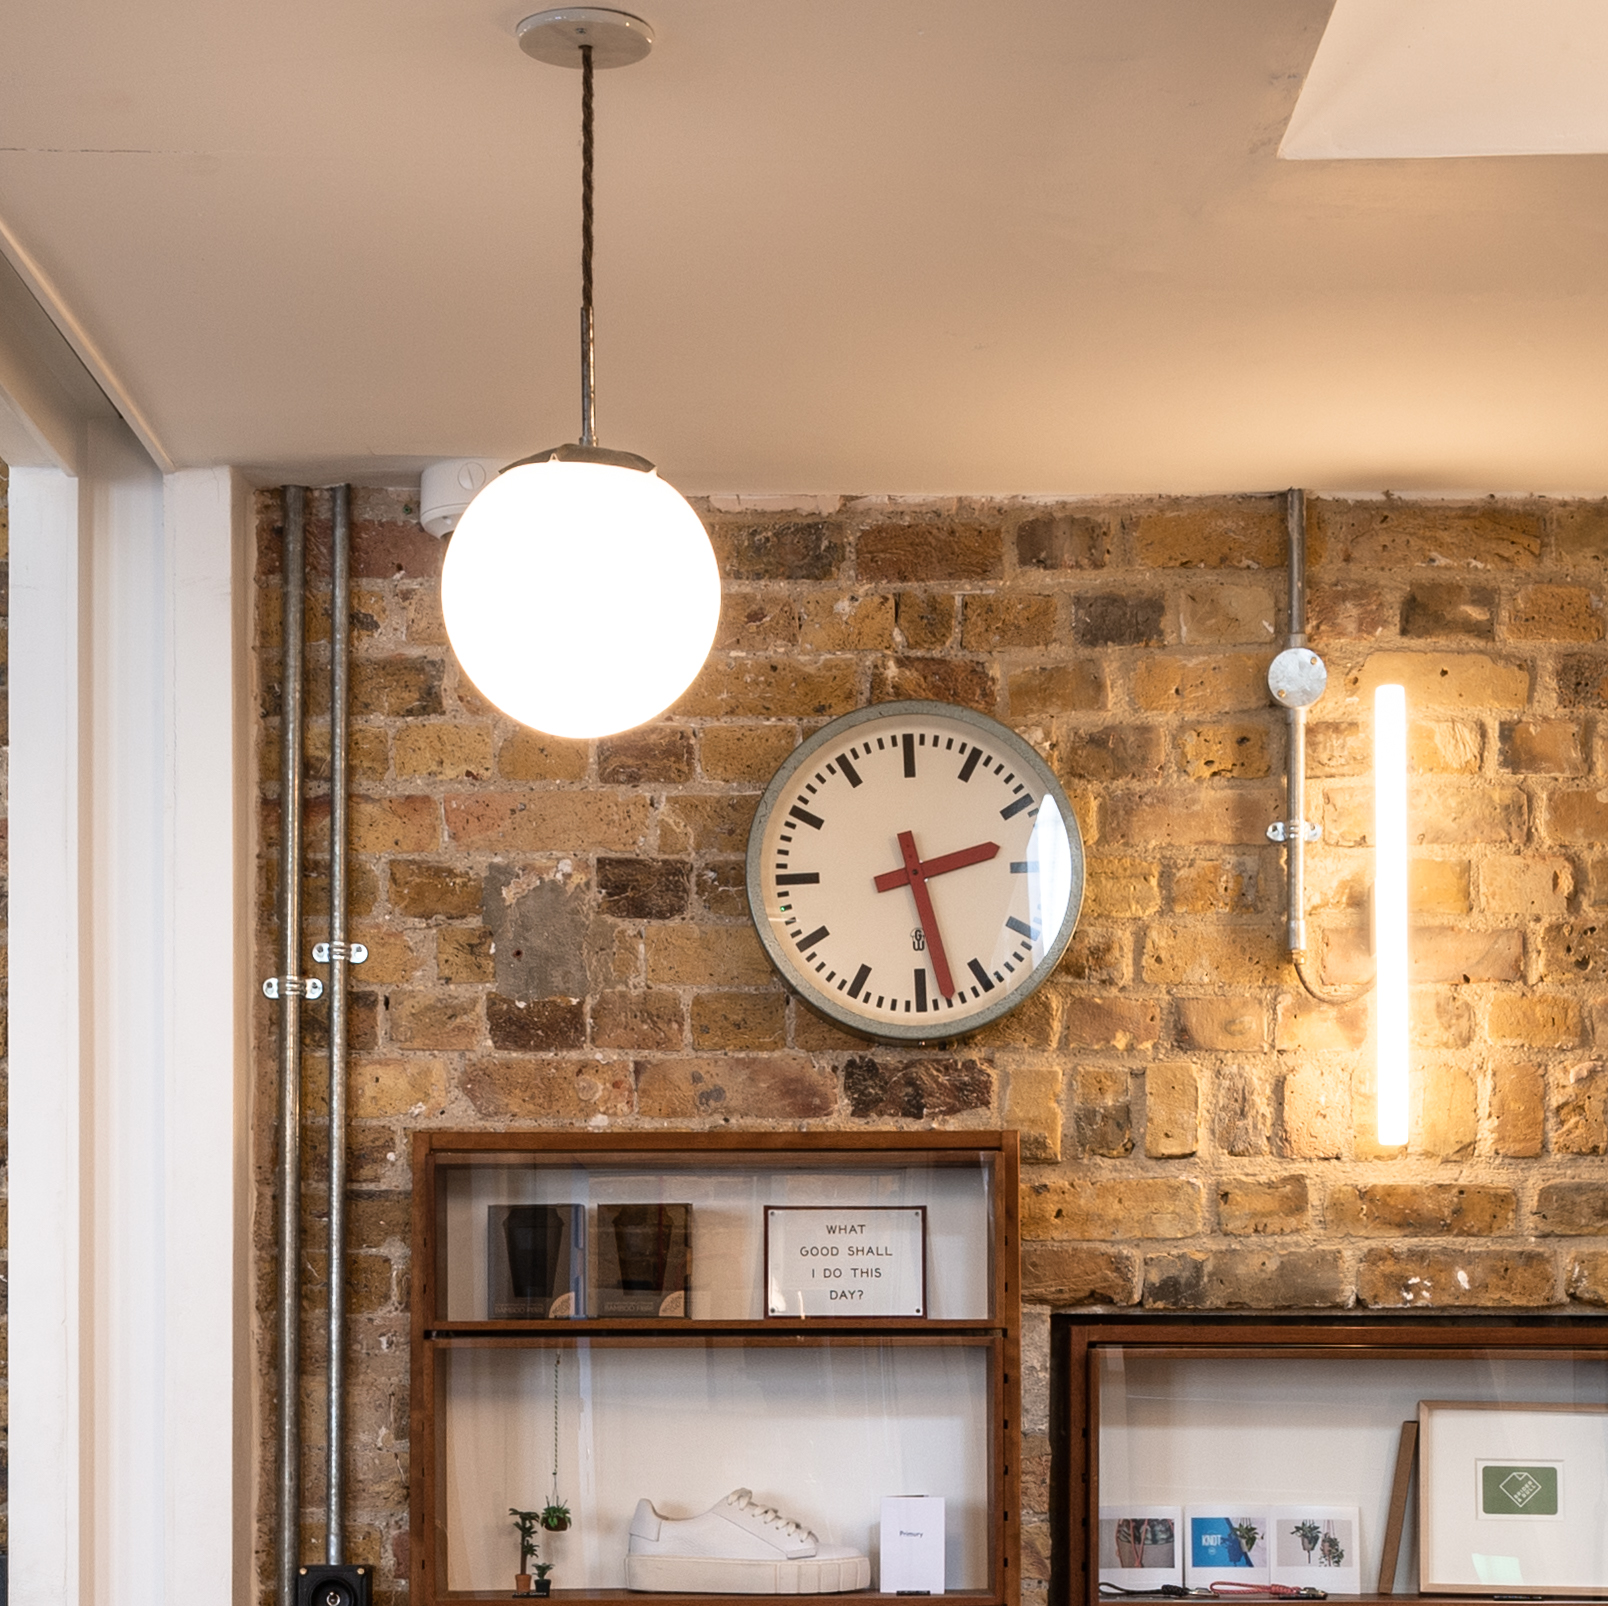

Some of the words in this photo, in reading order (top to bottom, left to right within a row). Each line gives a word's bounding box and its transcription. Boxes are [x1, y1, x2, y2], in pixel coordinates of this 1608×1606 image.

[826, 1224, 866, 1235] WHAT
[799, 1246, 840, 1257] GOOD
[847, 1246, 893, 1257] SHALL
[811, 1268, 815, 1278] I
[823, 1268, 842, 1278] DO
[850, 1268, 882, 1278] THIS
[829, 1290, 864, 1300] DAY?
[1201, 1534, 1223, 1547] KNOT
